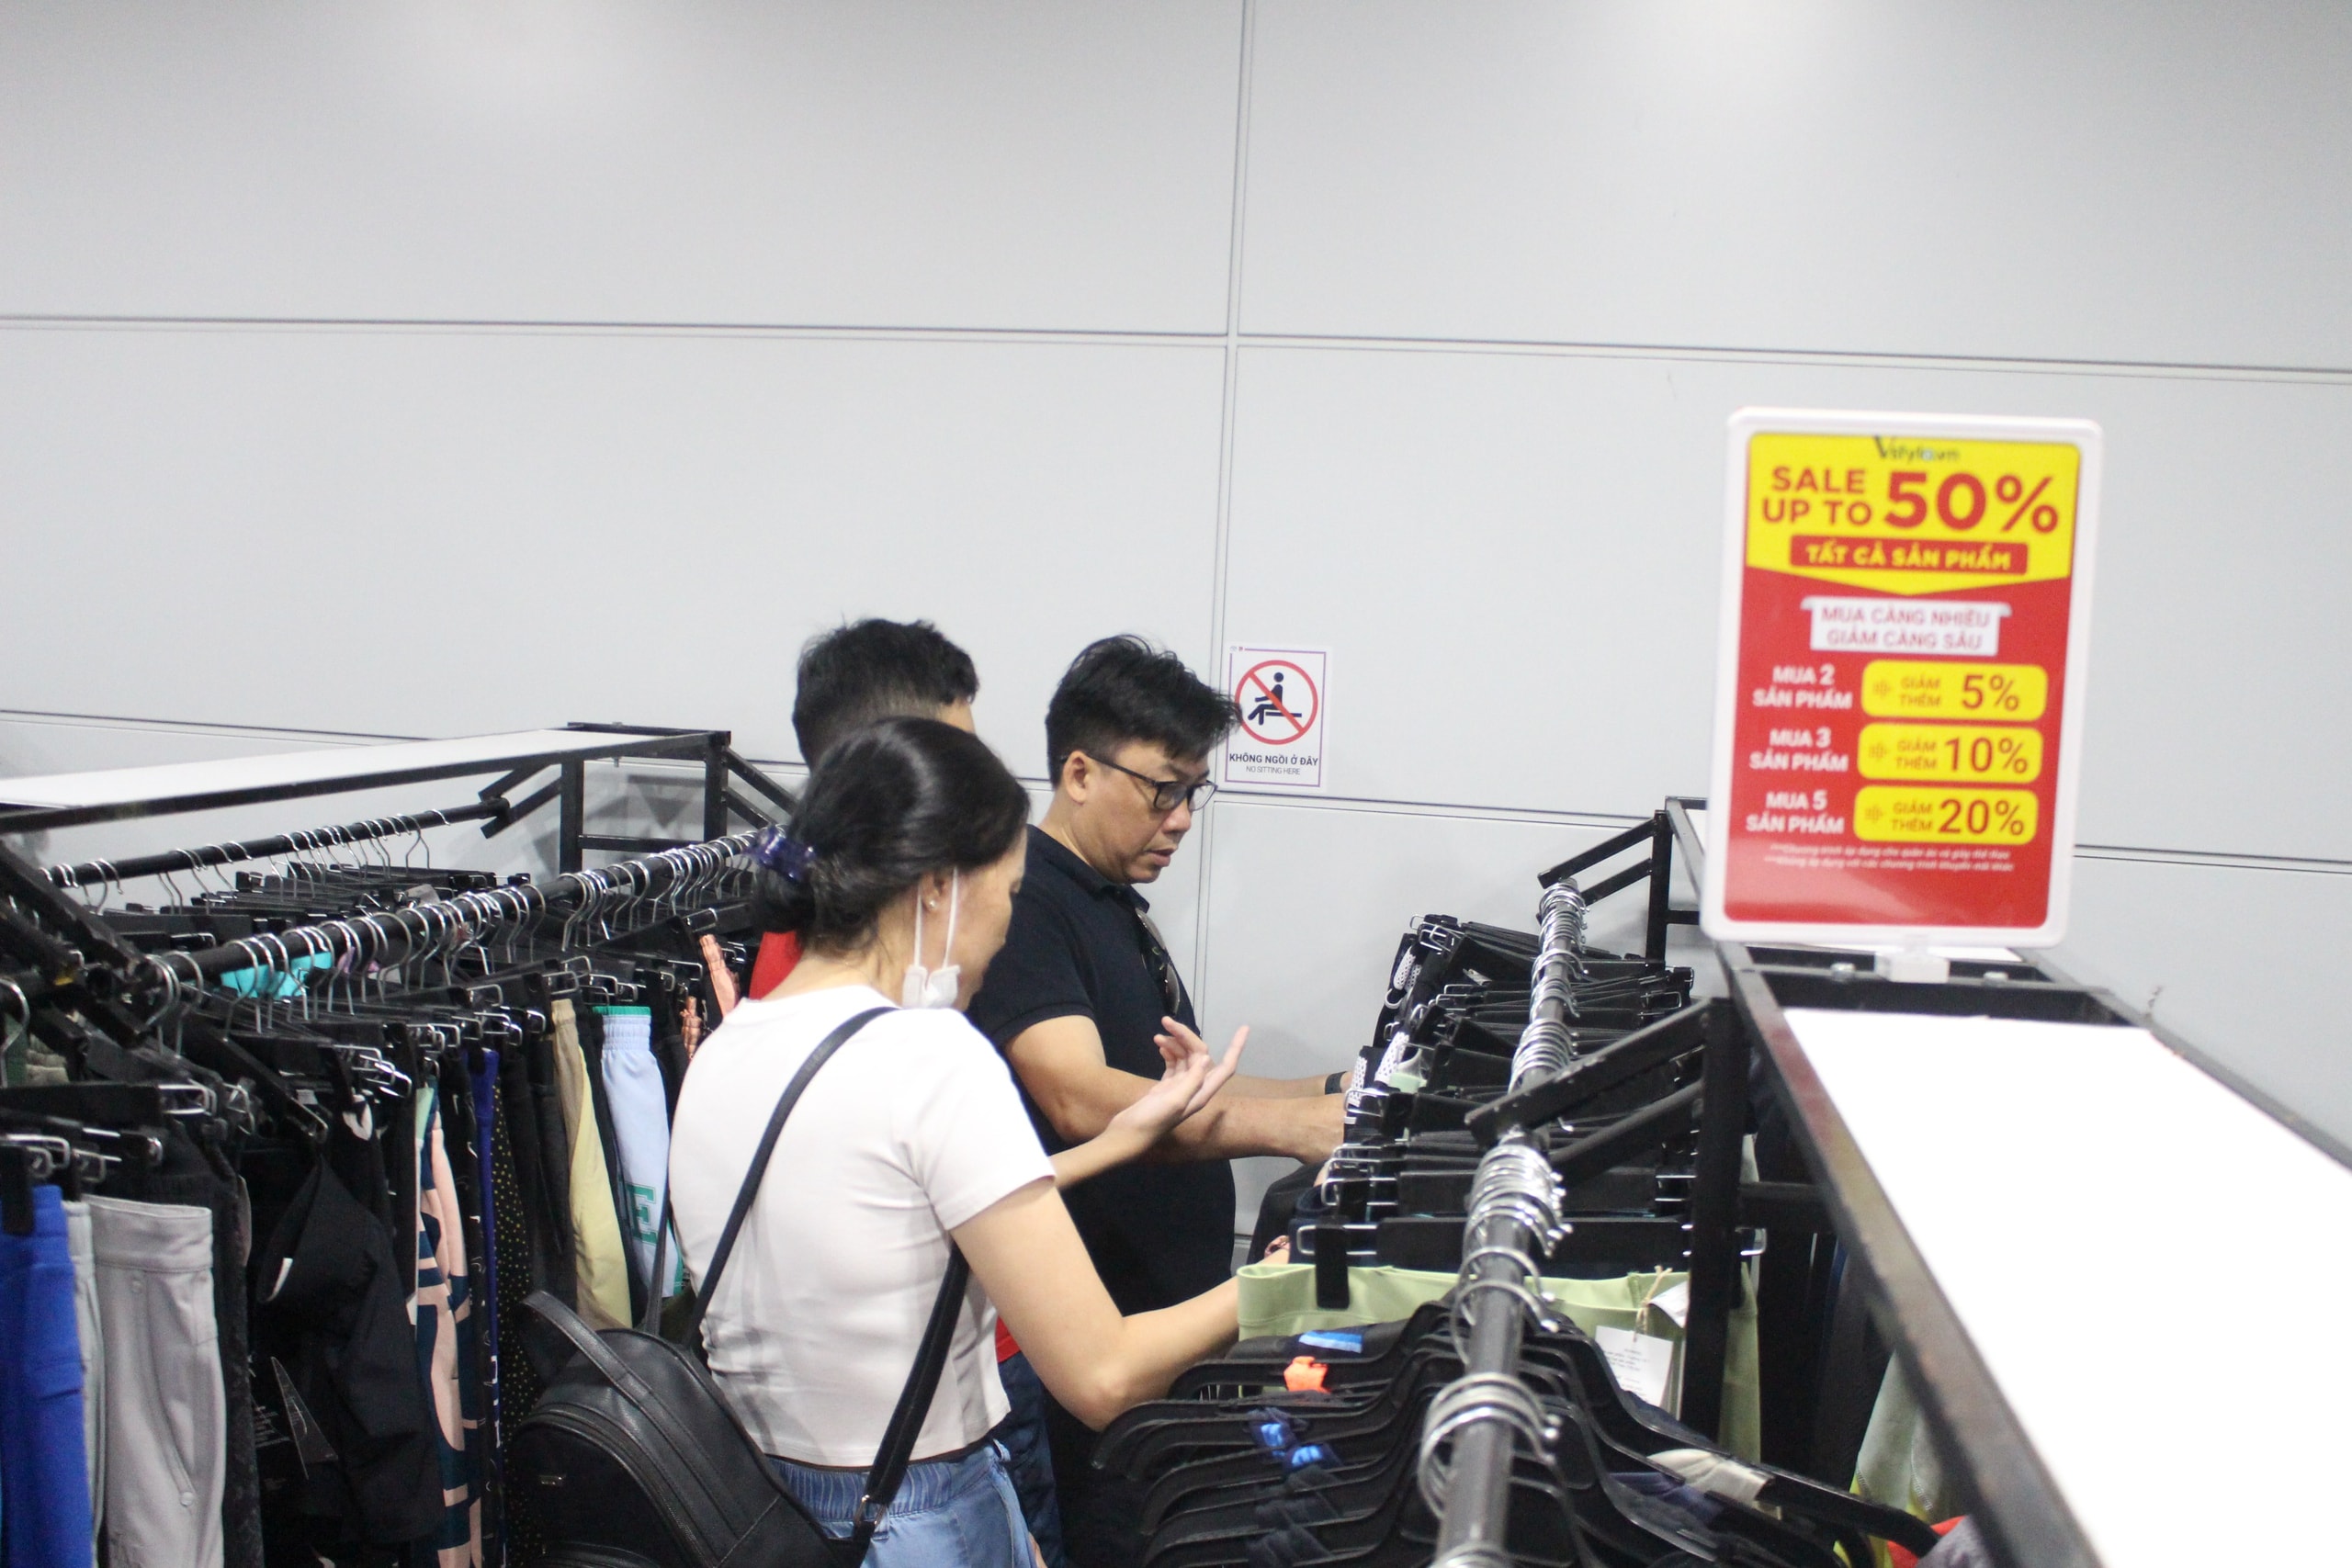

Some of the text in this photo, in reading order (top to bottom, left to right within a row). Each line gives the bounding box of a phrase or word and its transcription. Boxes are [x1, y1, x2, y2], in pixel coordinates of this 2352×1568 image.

[1772, 466, 1866, 494] SALE
[1761, 497, 1873, 526] UP TO
[1883, 470, 2060, 535] 50%
[1806, 539, 2012, 571] TẤT CẢ SẢN PHẨM
[1820, 602, 1991, 631] MUA CÀNG NHIỀU
[1826, 626, 1984, 651] GIẢM CÀNG SÂU
[1771, 663, 1837, 687] MUA 2
[1900, 674, 1941, 690] GIẢM
[1752, 685, 1854, 710] SẢN PHẨM
[1898, 691, 1942, 707] THÊM
[1960, 672, 2021, 714] 5%
[1769, 727, 1832, 750] MUA 3
[1896, 738, 1937, 752] GIẢM
[1229, 751, 1319, 766] KHÔNG NGỒI Ở ĐÂY
[1749, 749, 1849, 773] SẢN PHẨM
[1894, 754, 1939, 771] THÊM
[1944, 736, 2029, 775] 10%
[1257, 766, 1283, 774] SITTING
[1765, 789, 1828, 812] MUA 5
[1892, 799, 1932, 815] GIẢM
[1746, 811, 1846, 835] SẢN PHẨM
[1891, 817, 1934, 833] THÊM
[1937, 798, 2025, 837] 20%
